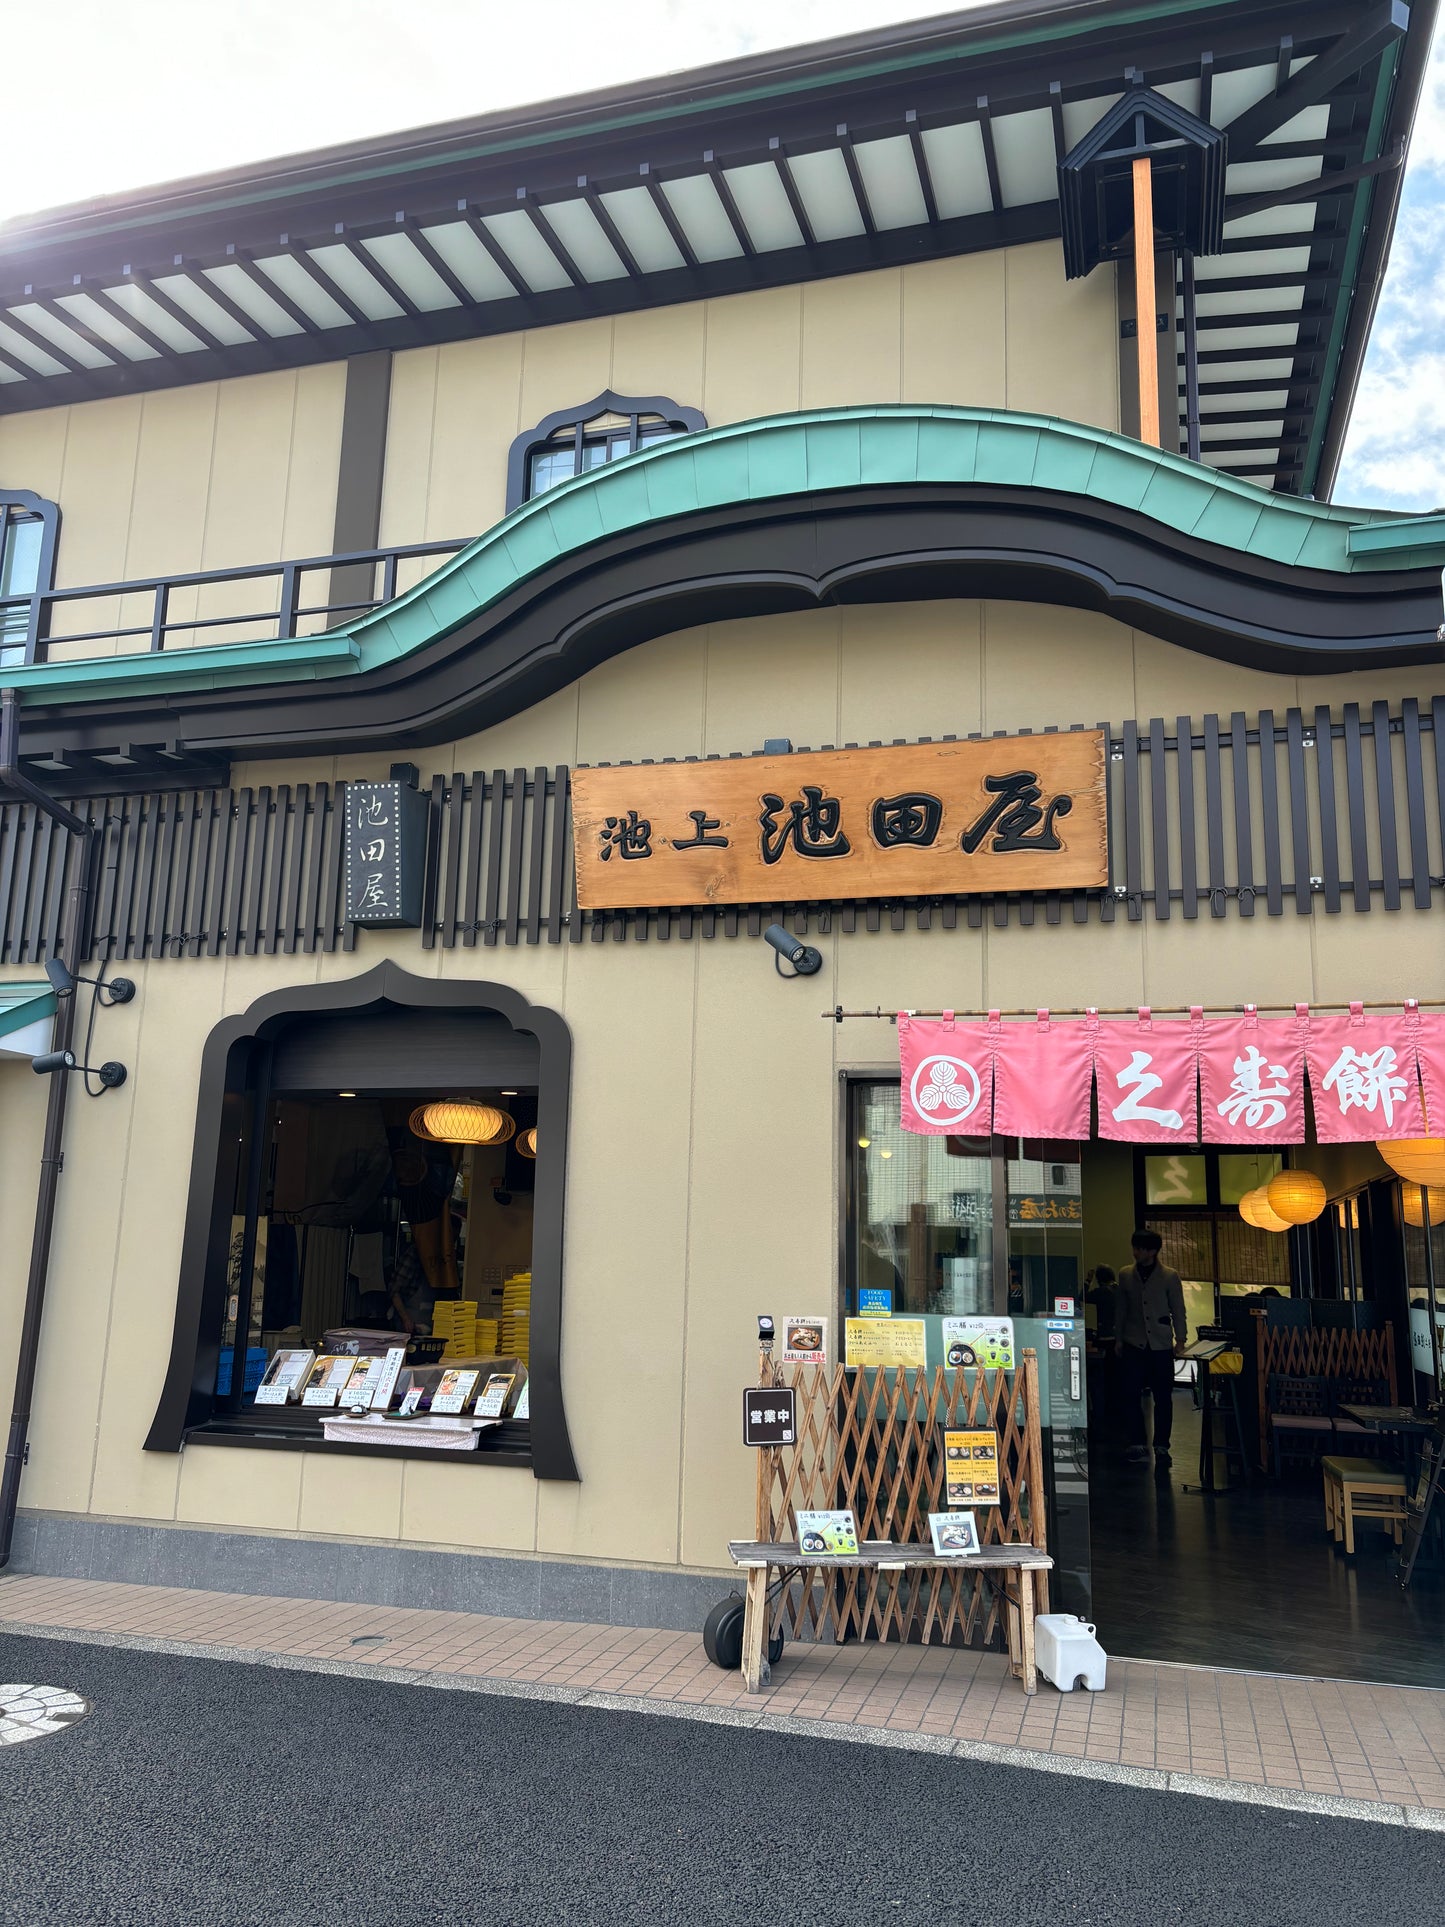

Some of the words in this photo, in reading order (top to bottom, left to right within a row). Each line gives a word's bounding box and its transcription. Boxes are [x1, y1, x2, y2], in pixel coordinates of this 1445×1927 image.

[358, 795, 389, 908] 池田屋
[750, 1409, 790, 1424] 営業中
